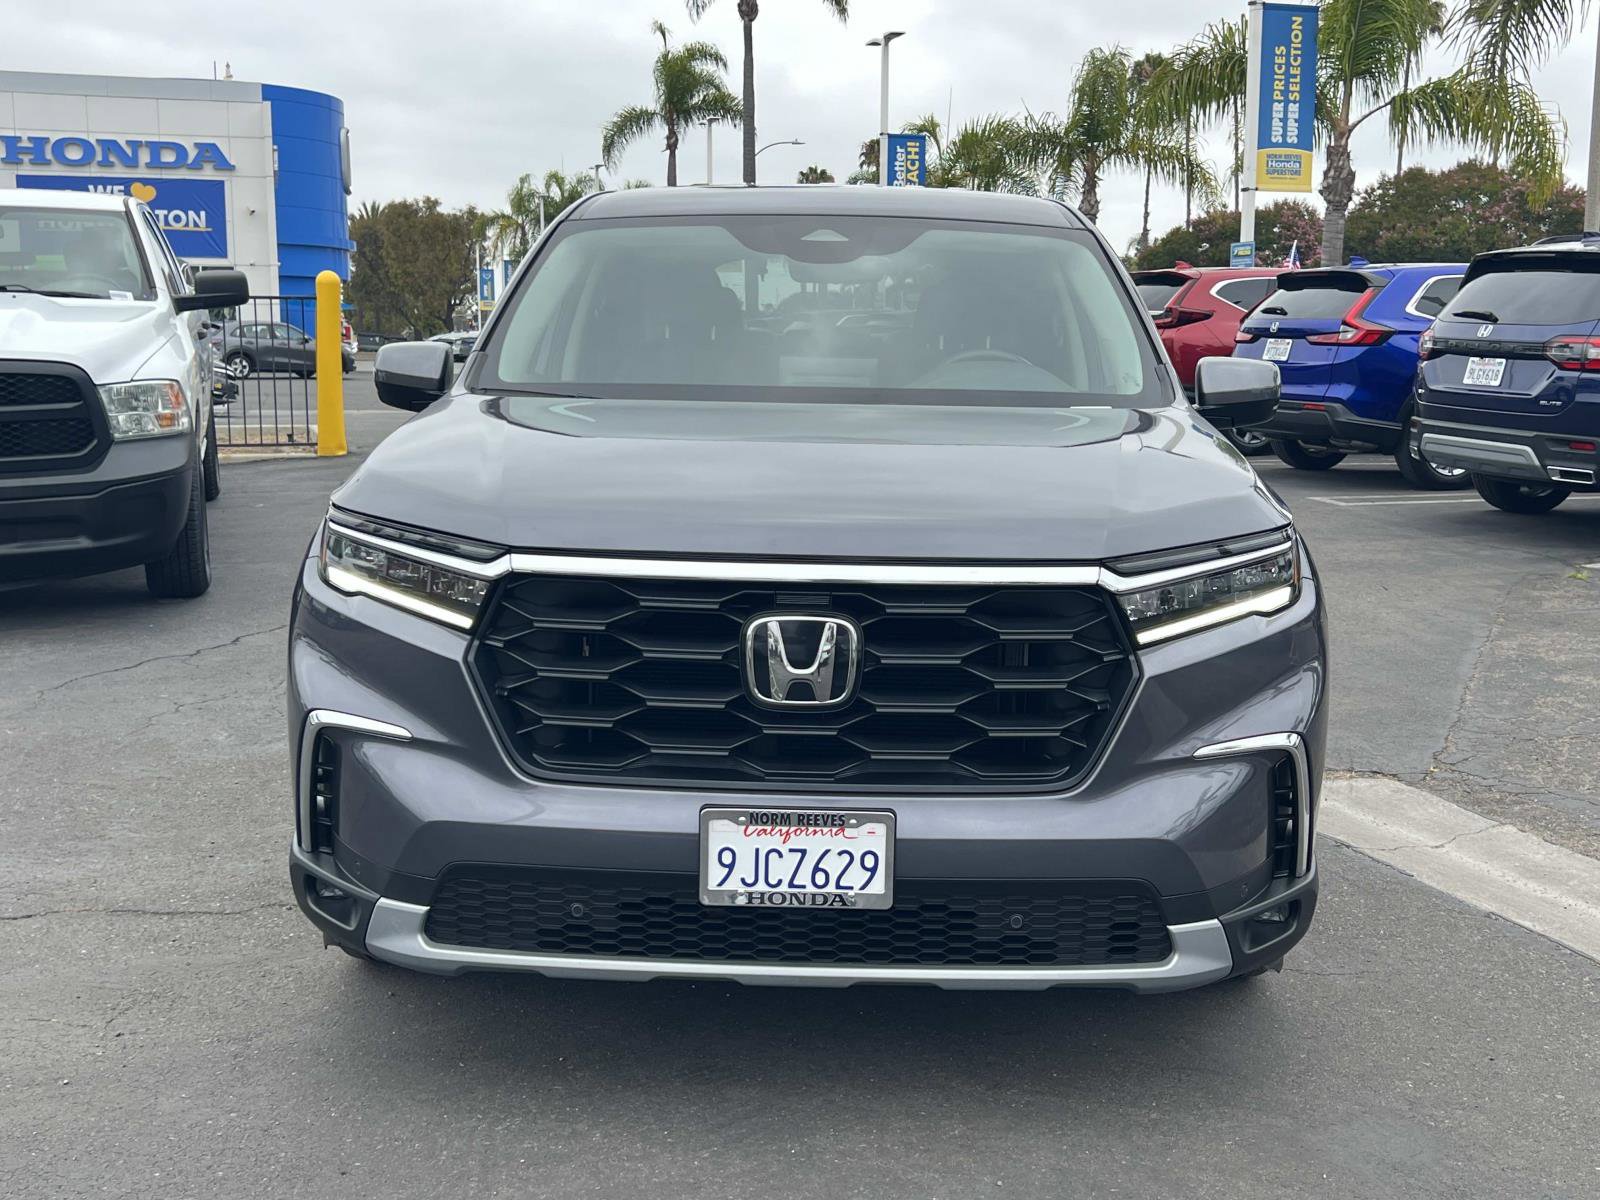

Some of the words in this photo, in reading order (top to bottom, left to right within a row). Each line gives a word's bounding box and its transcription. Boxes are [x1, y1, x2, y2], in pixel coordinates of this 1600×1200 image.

[1273, 45, 1287, 101] PRICES
[1288, 16, 1304, 101] SELECTION
[1271, 102, 1285, 144] SUPER
[1286, 102, 1299, 144] SUPER
[0, 135, 236, 171] HONDA
[893, 145, 906, 187] Better
[1268, 160, 1300, 168] Honda
[743, 823, 859, 845] California
[749, 811, 792, 826] NORM
[796, 813, 846, 828] REEVES
[716, 846, 880, 891] 9JCZ629
[745, 891, 849, 907] HONDA
